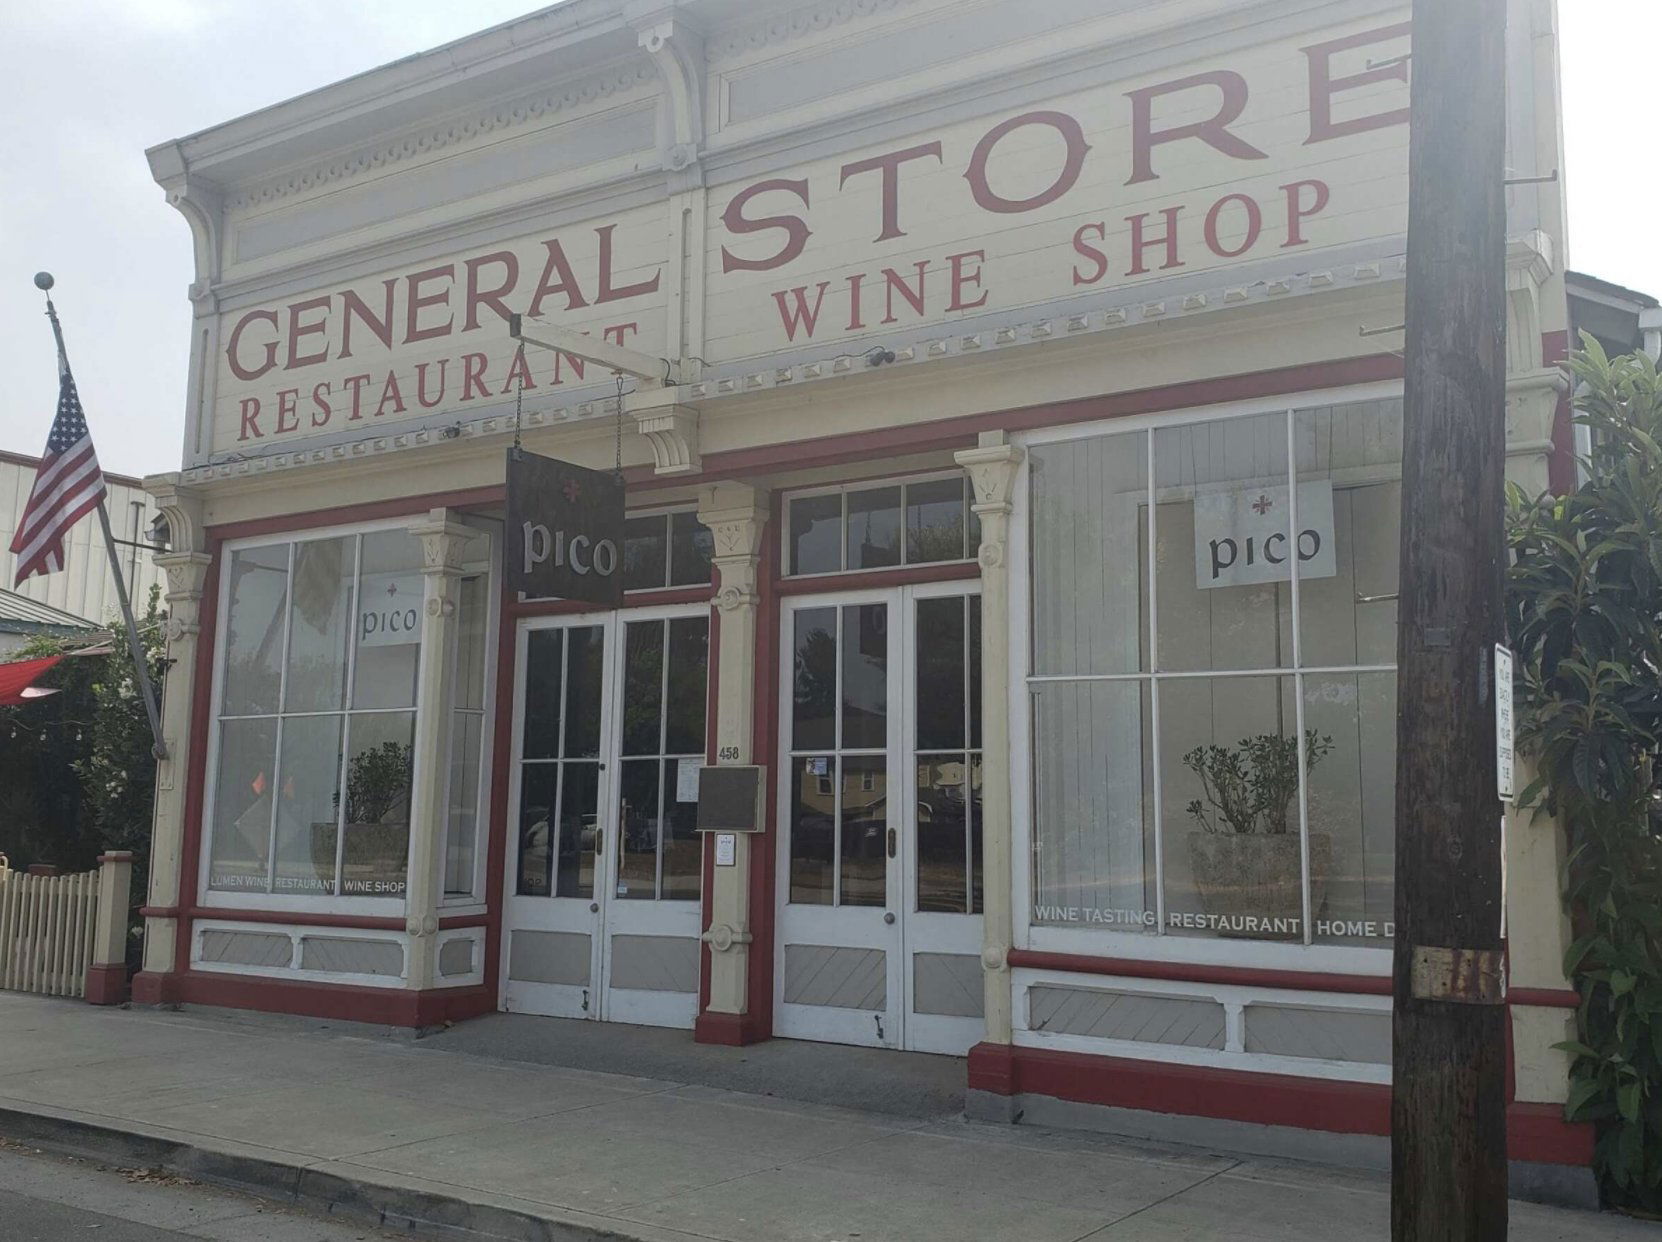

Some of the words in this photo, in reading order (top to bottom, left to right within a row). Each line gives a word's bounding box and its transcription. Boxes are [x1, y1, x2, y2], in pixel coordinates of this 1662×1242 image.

[226, 223, 661, 381] GENERAL
[719, 20, 1411, 274] STORE
[771, 250, 989, 342] WINE
[1072, 179, 1330, 286] SHOP
[237, 322, 637, 441] RESTAURANT
[523, 521, 617, 576] pico
[1209, 529, 1321, 579] pico
[362, 609, 417, 640] pico
[718, 747, 739, 760] 458
[211, 874, 242, 887] LUMEN
[244, 875, 269, 888] WINE
[275, 877, 335, 891] RESTAURANT
[344, 880, 371, 892] WINE
[375, 881, 405, 893] SHOP
[1035, 905, 1078, 922] WINE
[1083, 907, 1155, 926] TASTING
[1170, 912, 1300, 933] RESTAURANT
[1317, 920, 1377, 936] HOME
